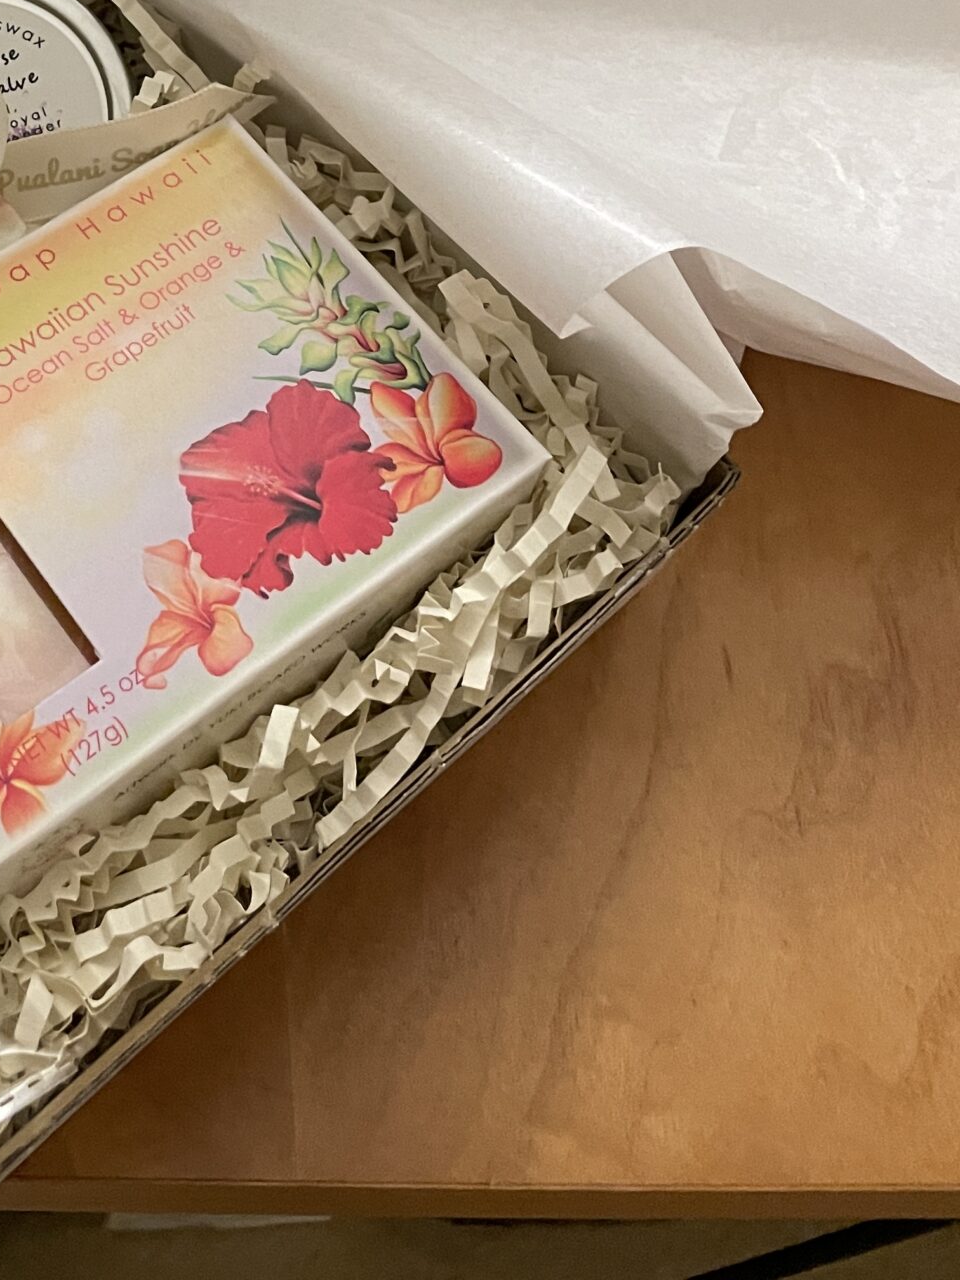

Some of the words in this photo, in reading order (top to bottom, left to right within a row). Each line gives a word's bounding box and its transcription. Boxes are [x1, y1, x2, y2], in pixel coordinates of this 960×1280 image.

[10, 106, 47, 128] oyal
[76, 148, 212, 240] Hawaii
[73, 315, 116, 354] Salt
[121, 308, 140, 325] &
[139, 253, 227, 311] Orange
[225, 239, 247, 258] &
[105, 217, 222, 296] Sunshine
[84, 303, 197, 383] Grapefruit
[8, 734, 47, 768] NET
[46, 707, 82, 738] WT
[87, 684, 115, 715] 4.5
[118, 668, 146, 692] oz
[60, 716, 129, 776] (127g)
